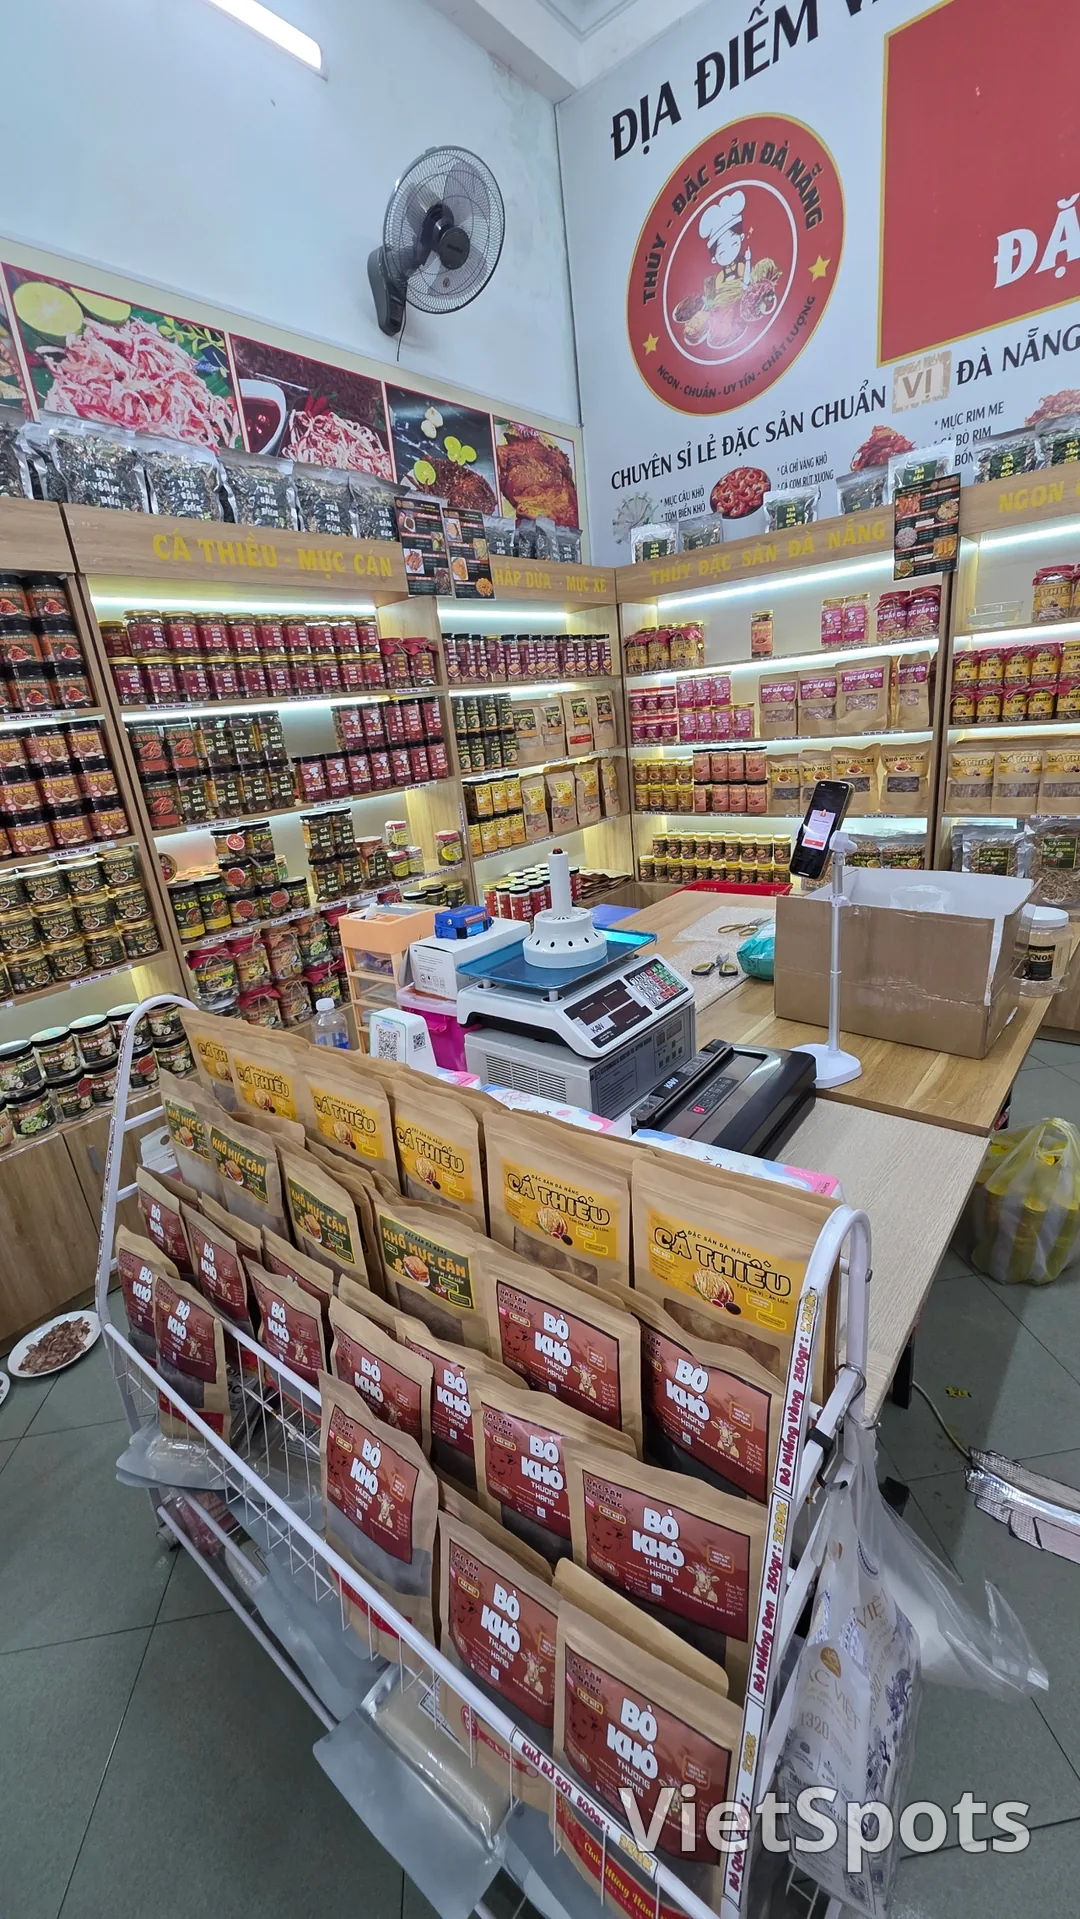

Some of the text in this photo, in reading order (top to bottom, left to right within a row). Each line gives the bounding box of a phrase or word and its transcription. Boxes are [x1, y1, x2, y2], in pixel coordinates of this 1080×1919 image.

[611, 81, 682, 161] ĐỊA
[671, 164, 711, 218] ĐẶC
[713, 138, 757, 176] SẢN
[759, 140, 791, 172] ĐÀ
[785, 156, 825, 231] NẴNG
[656, 364, 680, 391] NGON
[723, 382, 737, 396] UY
[738, 371, 756, 390] TÍN
[611, 452, 672, 490] CHUYÊN
[677, 441, 692, 471] SỈ
[697, 433, 718, 465] LẺ
[721, 425, 760, 458] ĐẶC
[765, 410, 804, 444] SẢN
[811, 379, 886, 430] CHUẨN
[902, 367, 932, 400] VỊ
[956, 346, 993, 386] ĐÀ
[941, 401, 1005, 431] MỰC RIM ME
[998, 482, 1066, 514] NGON
[153, 528, 191, 562] CÁ
[297, 547, 345, 580] MỰC
[353, 546, 393, 578] CÁN
[650, 518, 886, 586] THÚY ĐẶC SẢN ĐÀ NẴNG
[566, 574, 590, 597] MỰC
[236, 1062, 291, 1099] CÁ THIỀU
[313, 1095, 377, 1134] CÁ THIỀU
[228, 1148, 245, 1166] MỰC
[395, 1126, 465, 1175] CÁ THIỀU
[151, 1203, 161, 1221] BÒ
[306, 1200, 325, 1222] MỰC
[507, 1173, 611, 1227] CÁ THIỀU
[149, 1218, 165, 1238] KHÔ
[688, 1229, 753, 1259] ĐẶC SẢN ĐÀ NẴNG
[200, 1257, 218, 1281] KHÔ
[203, 1242, 215, 1262] BÒ
[383, 1227, 467, 1277] KHÔ MỰC CÁN
[653, 1226, 792, 1298] CÁ THIỀU
[167, 1315, 188, 1340] KHÔ
[175, 1300, 192, 1322] BÒ
[270, 1301, 287, 1323] BÒ
[543, 1311, 569, 1341] BÒ
[267, 1316, 290, 1343] KHÔ
[534, 1331, 572, 1368] KHÔ
[361, 1356, 382, 1383] BÒ
[443, 1368, 468, 1396] BÒ
[674, 1358, 710, 1394] BÒ
[354, 1371, 384, 1403] KHÔ
[436, 1385, 472, 1418] KHÔ
[665, 1378, 711, 1422] KHÔ
[786, 1389, 804, 1424] Vàng
[361, 1438, 382, 1469] BÒ
[528, 1434, 560, 1465] BÒ
[780, 1424, 800, 1468] Miếng
[350, 1458, 379, 1496] KHÔ
[520, 1455, 564, 1491] KHÔ
[779, 1466, 791, 1487] Bò
[643, 1506, 680, 1541] BÒ
[773, 1500, 788, 1545] 239K
[632, 1529, 685, 1567] KHÔ
[493, 1583, 521, 1622] BÒ
[761, 1600, 776, 1633] Đen
[480, 1604, 521, 1653] KHÔ
[754, 1630, 775, 1676] Miếng
[753, 1672, 765, 1696] Bò
[620, 1697, 658, 1743] BÒ
[606, 1723, 659, 1780] KHÔ
[729, 1871, 741, 1894] Bò
